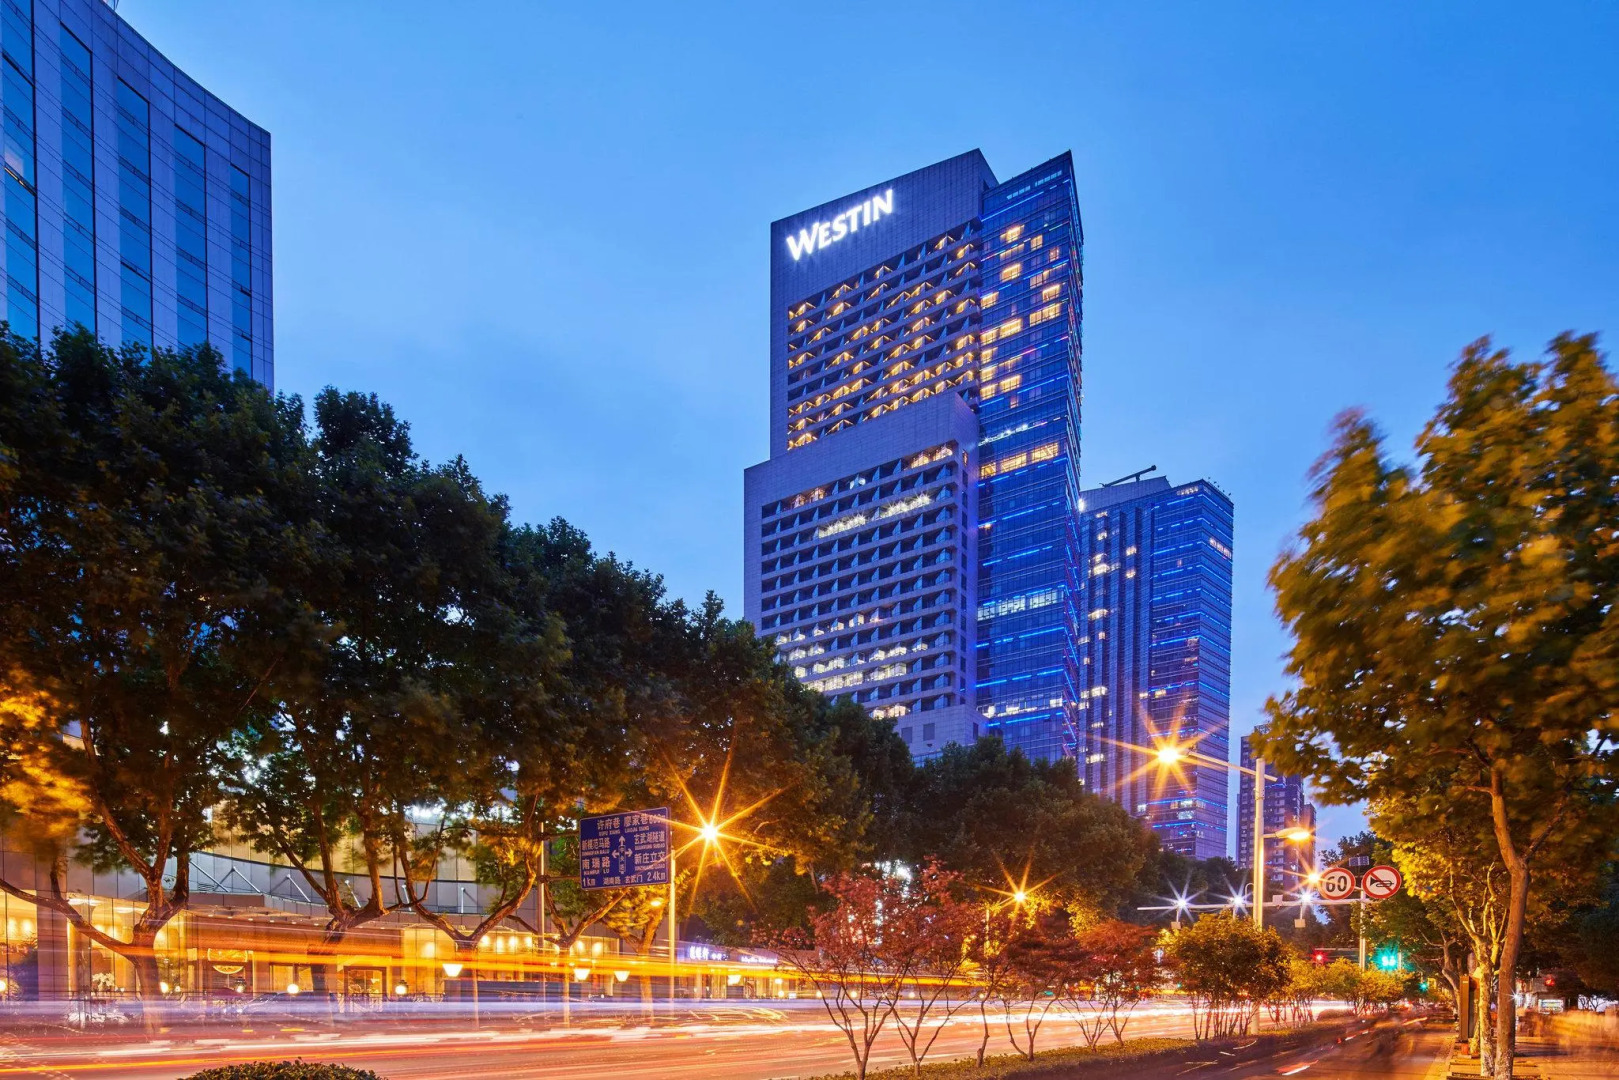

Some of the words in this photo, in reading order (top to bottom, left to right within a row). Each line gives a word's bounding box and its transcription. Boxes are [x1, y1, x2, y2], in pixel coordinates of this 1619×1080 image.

[786, 189, 893, 261] WESTIN
[634, 851, 665, 864] 新庄立交
[1326, 876, 1347, 892] 60
